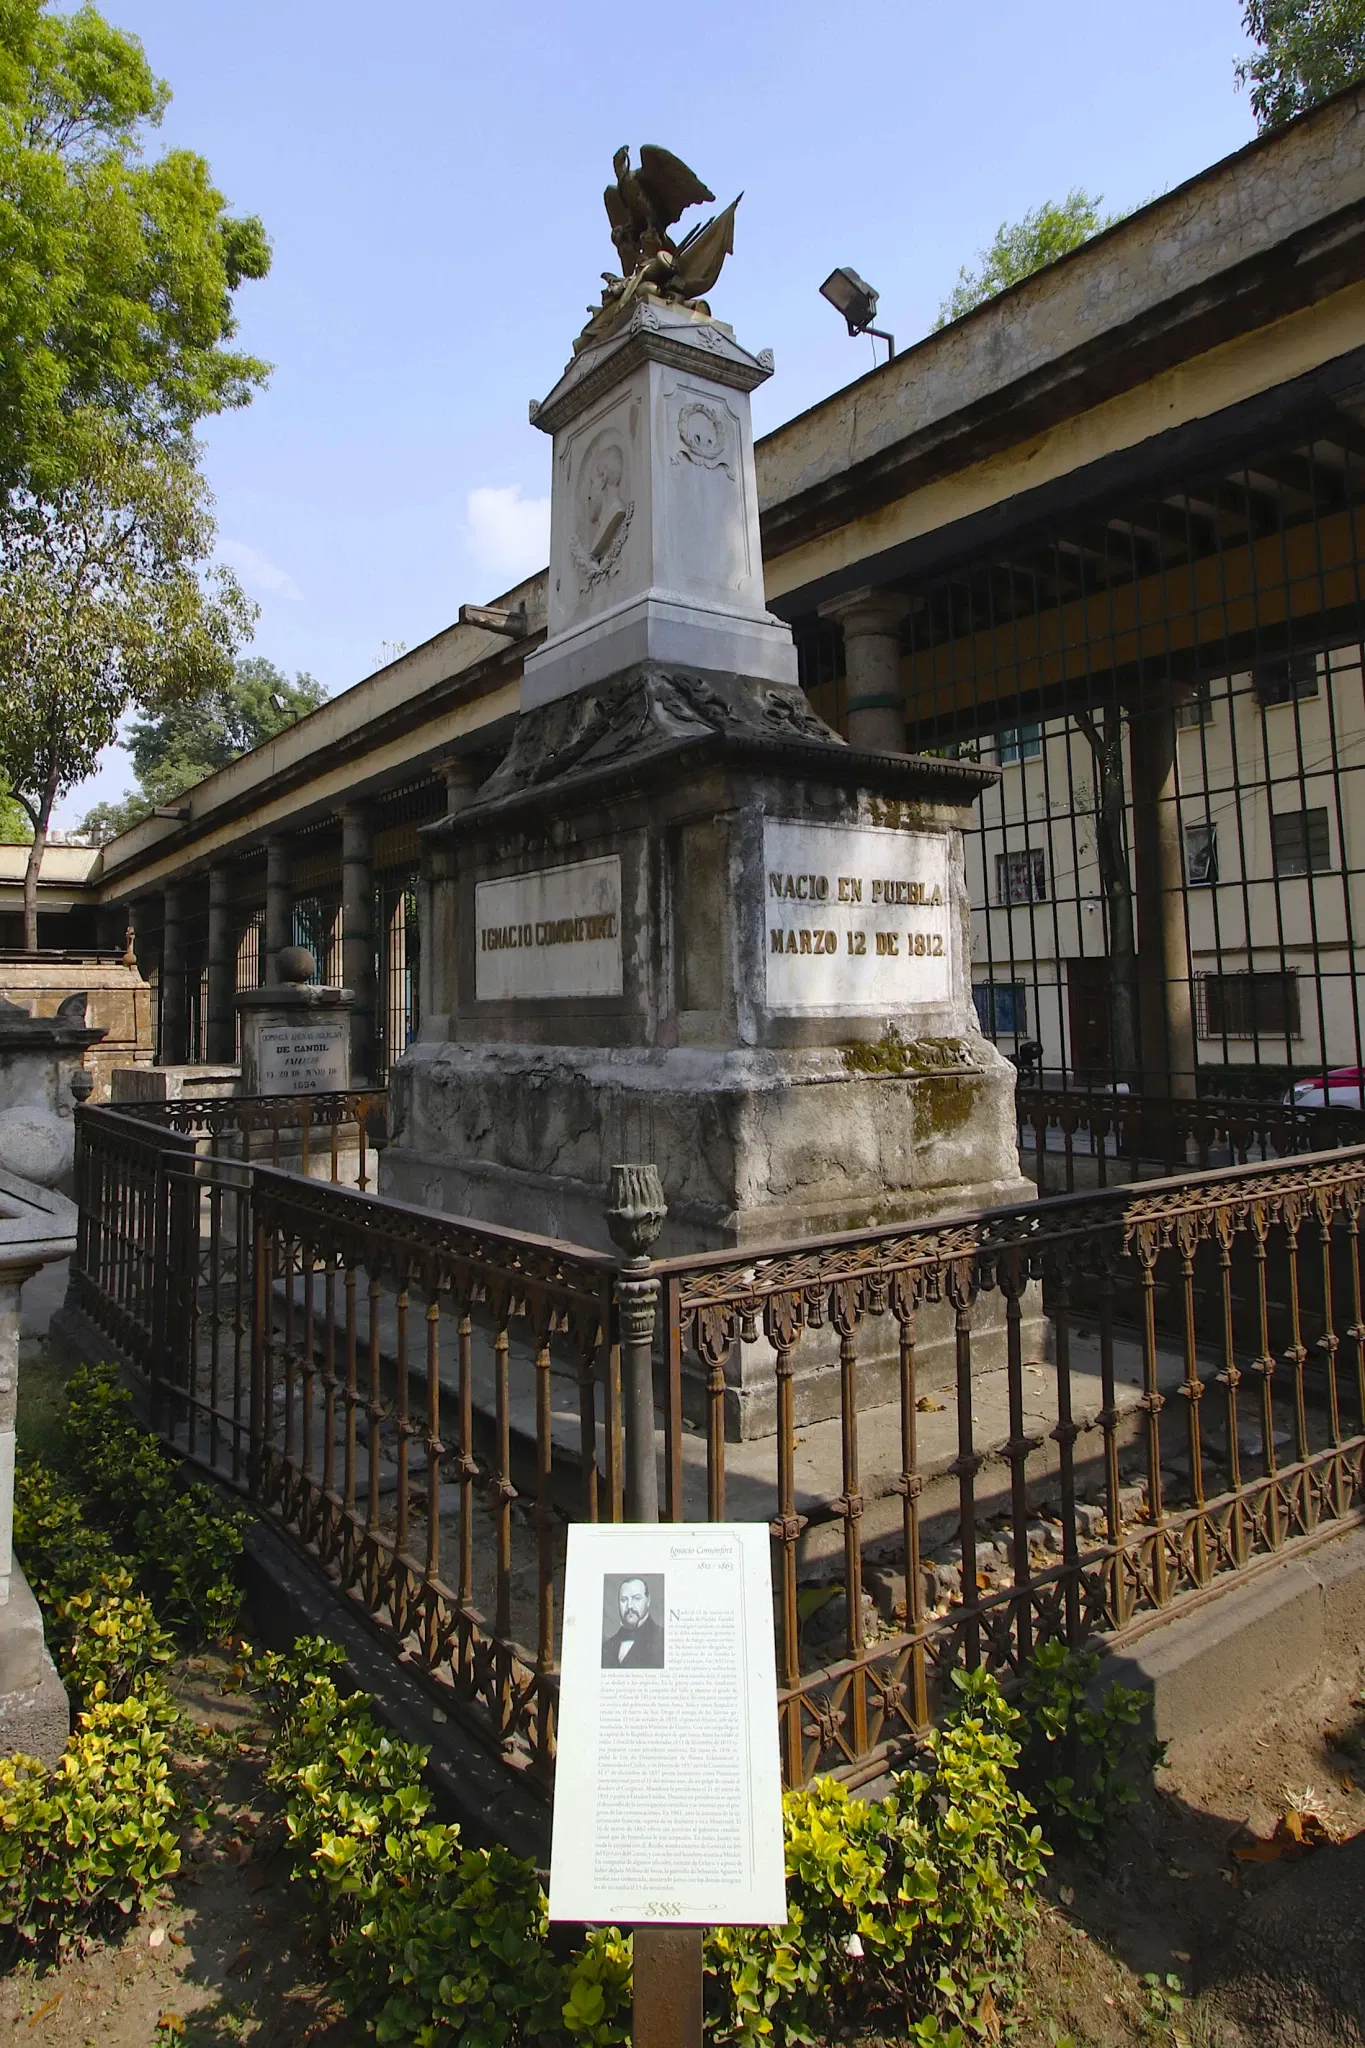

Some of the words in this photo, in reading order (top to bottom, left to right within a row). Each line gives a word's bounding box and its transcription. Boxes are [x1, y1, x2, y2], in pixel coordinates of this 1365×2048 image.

[769, 872, 829, 900] NACIO
[838, 876, 863, 902] EN
[872, 879, 941, 906] PUEBLA
[481, 923, 533, 952] IGNACIO
[770, 928, 838, 955] MARZO
[847, 930, 867, 955] 12
[875, 931, 899, 956] DE
[276, 1046, 290, 1054] DE
[670, 1545, 694, 1558] Ignacio
[696, 1545, 733, 1556] Comonfort
